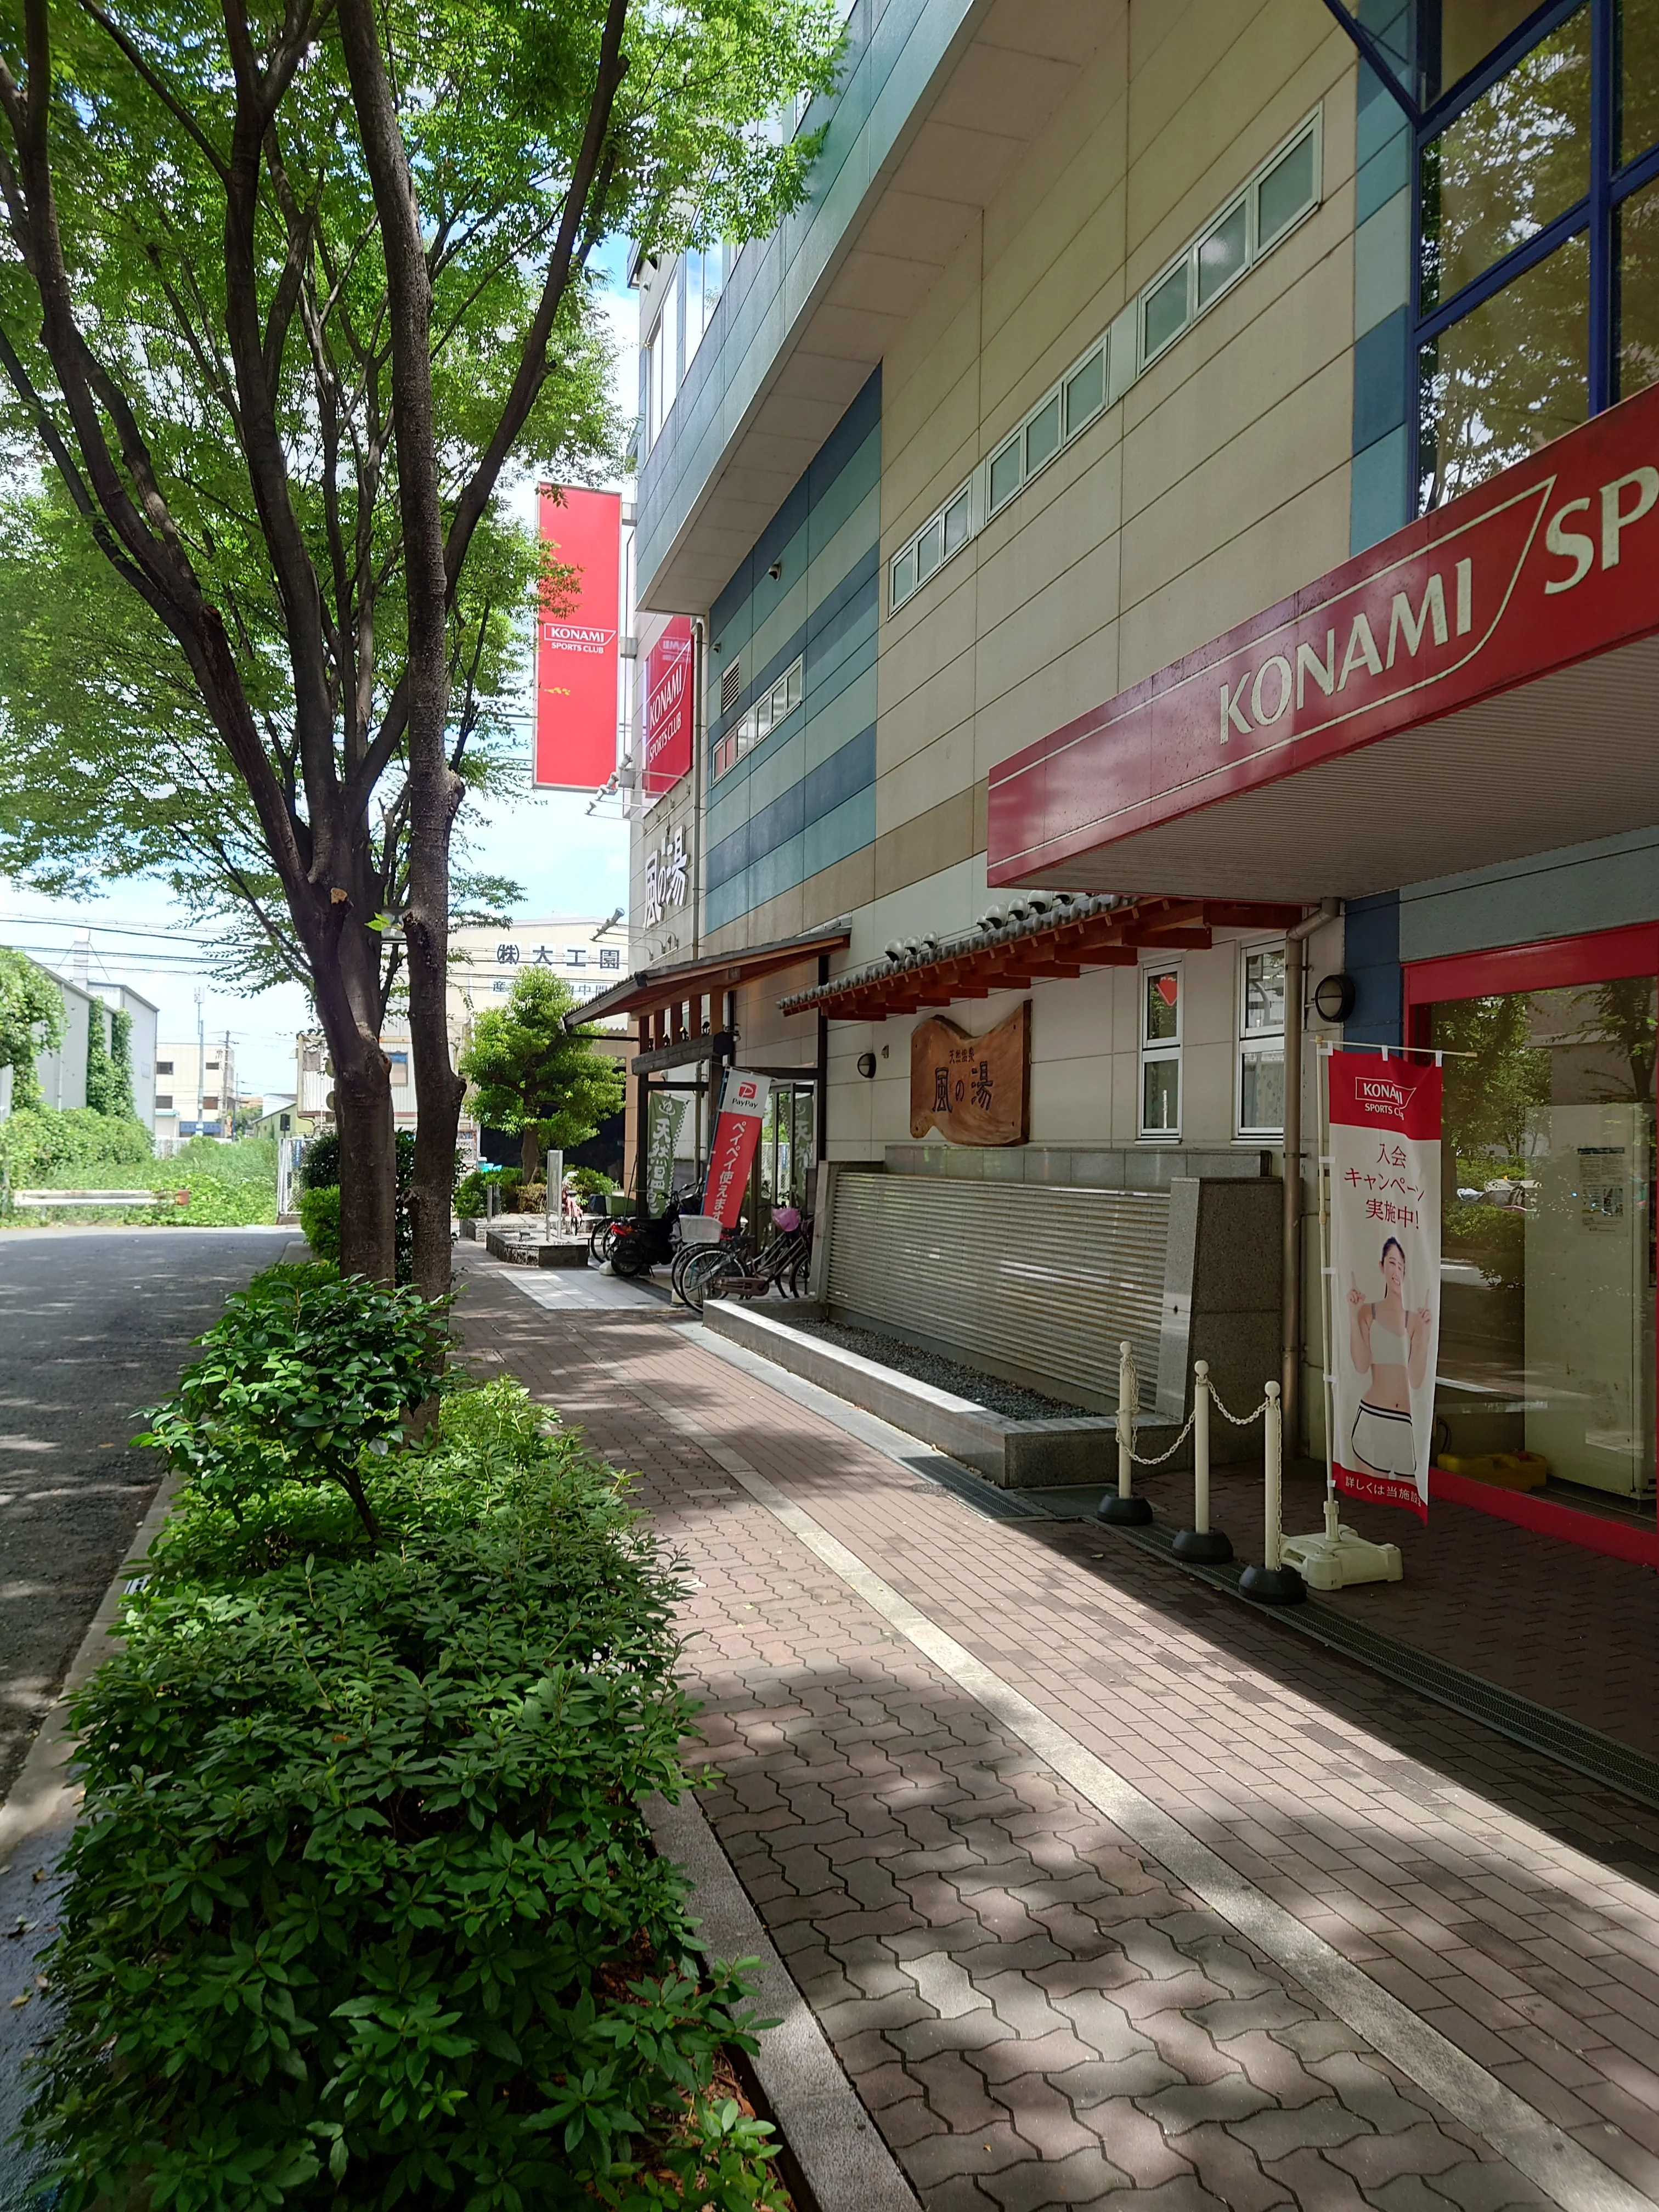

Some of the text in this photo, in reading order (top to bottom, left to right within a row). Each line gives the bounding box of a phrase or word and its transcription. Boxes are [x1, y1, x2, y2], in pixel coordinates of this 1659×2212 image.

[1220, 466, 1659, 745] KONAMI SP
[551, 627, 605, 643] KONAMI
[551, 642, 604, 654] SPORTS CLUB
[650, 664, 682, 730] KONAMI
[650, 711, 681, 763] SPORTS CLUB
[643, 826, 687, 930] 風の湯
[949, 1047, 974, 1064] 天然温泉
[932, 1060, 994, 1113] 風の湯
[1363, 1082, 1403, 1104] KONAI
[732, 1098, 758, 1109] PayPay
[1365, 1103, 1393, 1114] SPORTS
[1376, 1143, 1407, 1169] 入会
[1344, 1167, 1425, 1201] キャンペーン
[1365, 1199, 1420, 1229] 実施中!
